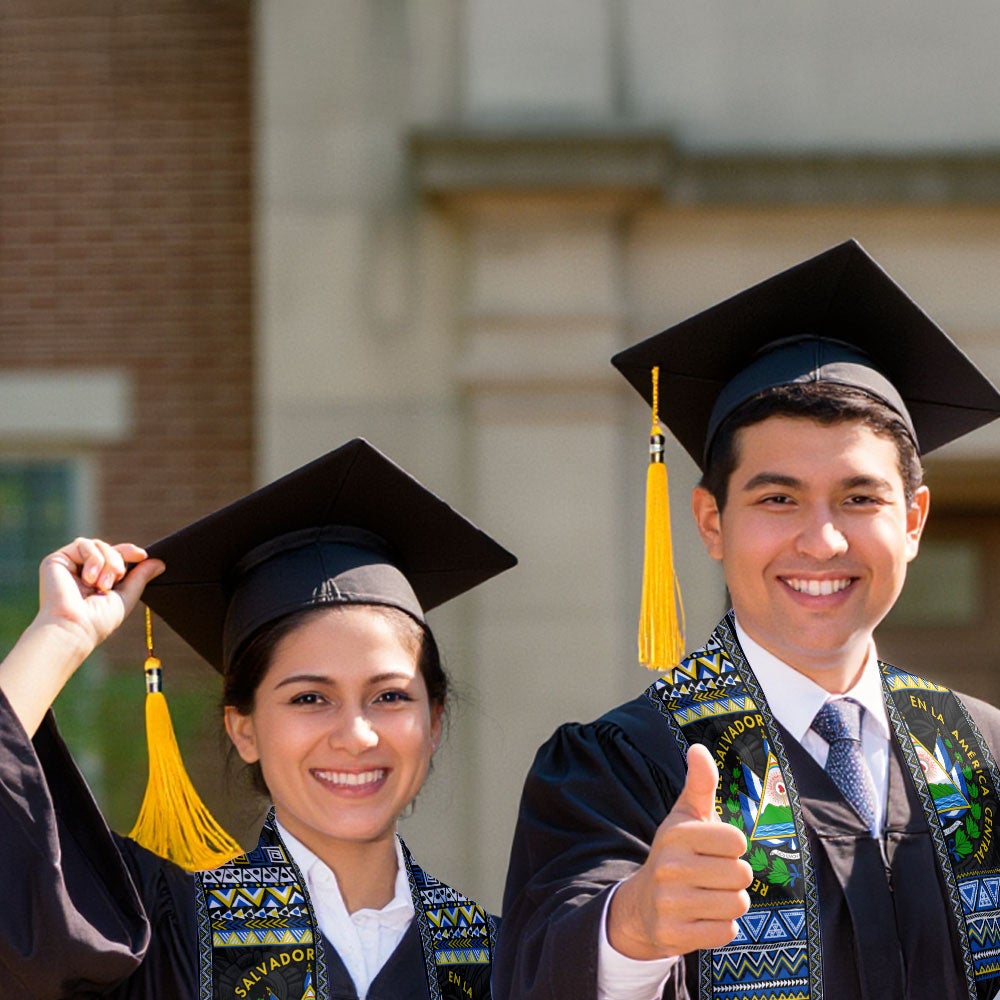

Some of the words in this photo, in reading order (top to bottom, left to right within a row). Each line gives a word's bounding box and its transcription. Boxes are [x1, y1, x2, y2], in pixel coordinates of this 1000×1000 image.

[716, 714, 765, 769] SALVADOR
[909, 695, 927, 712] EN
[931, 707, 945, 725] LA
[973, 806, 993, 865] CENTRAL
[234, 947, 315, 998] SALVADOR
[448, 970, 461, 987] EN
[462, 985, 473, 999] LA
